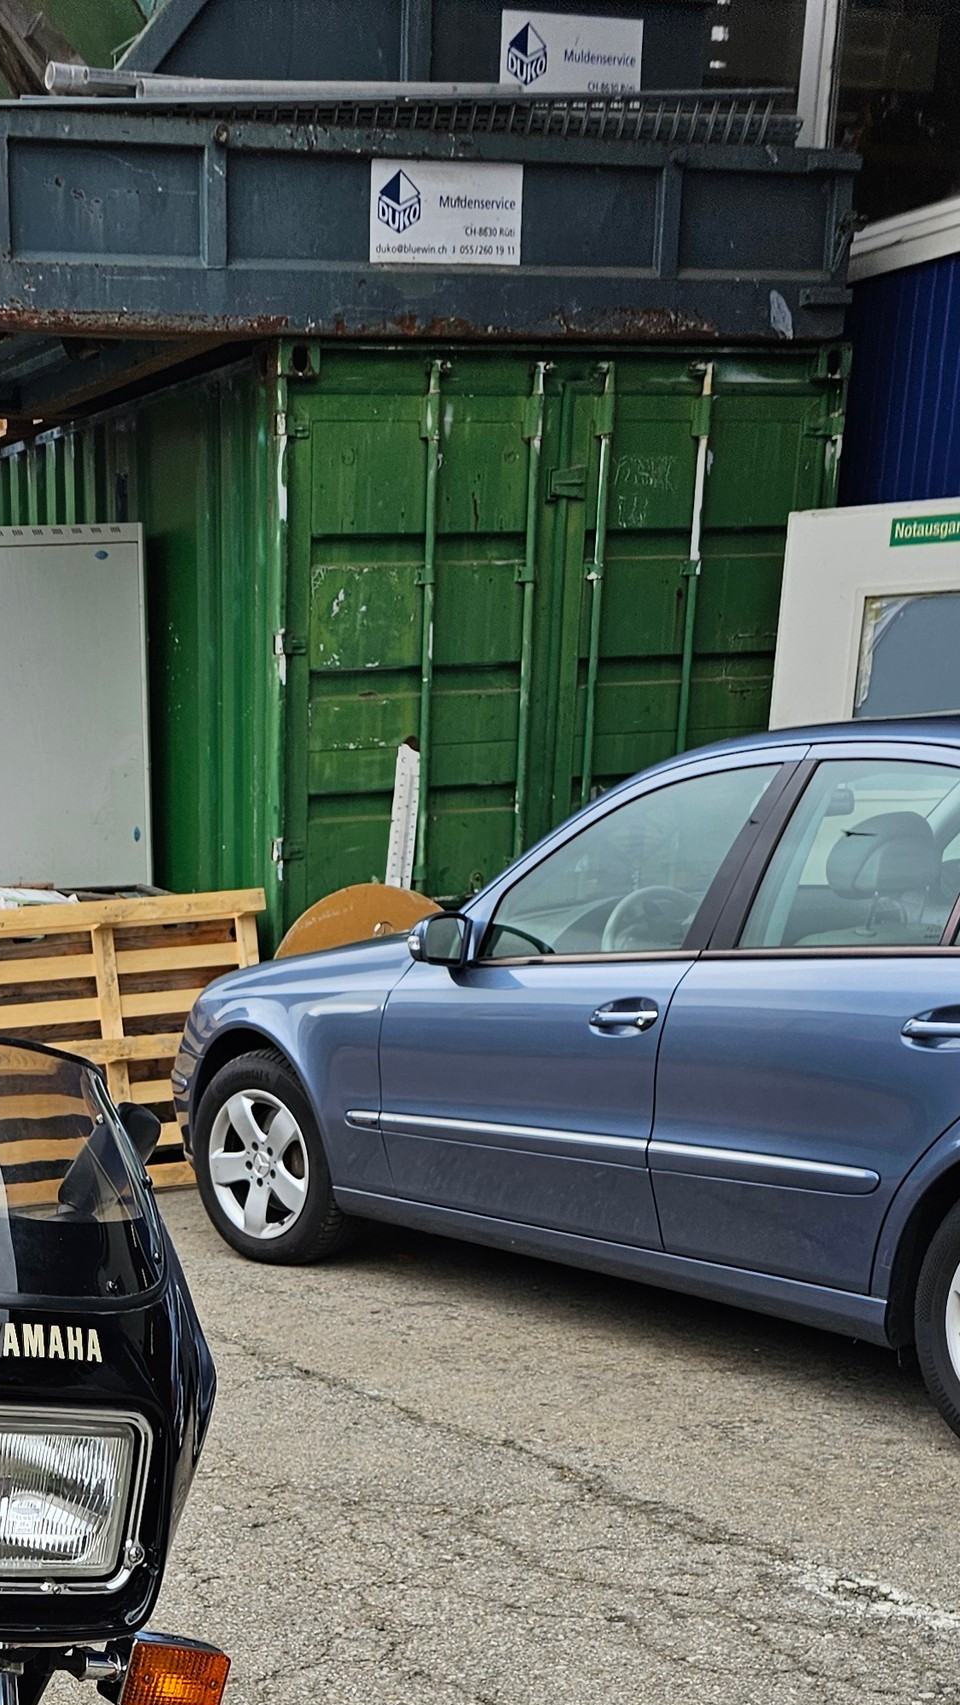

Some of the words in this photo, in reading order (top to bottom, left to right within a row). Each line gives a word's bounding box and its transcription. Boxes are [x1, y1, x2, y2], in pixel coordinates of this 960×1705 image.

[563, 48, 637, 67] Muldenservice
[508, 51, 546, 85] DUKO
[439, 195, 516, 211] Muldenservice
[378, 199, 420, 233] DUKO
[375, 243, 447, 255] duko@bluewin.ch
[496, 245, 504, 255] 19
[507, 245, 515, 255] 11
